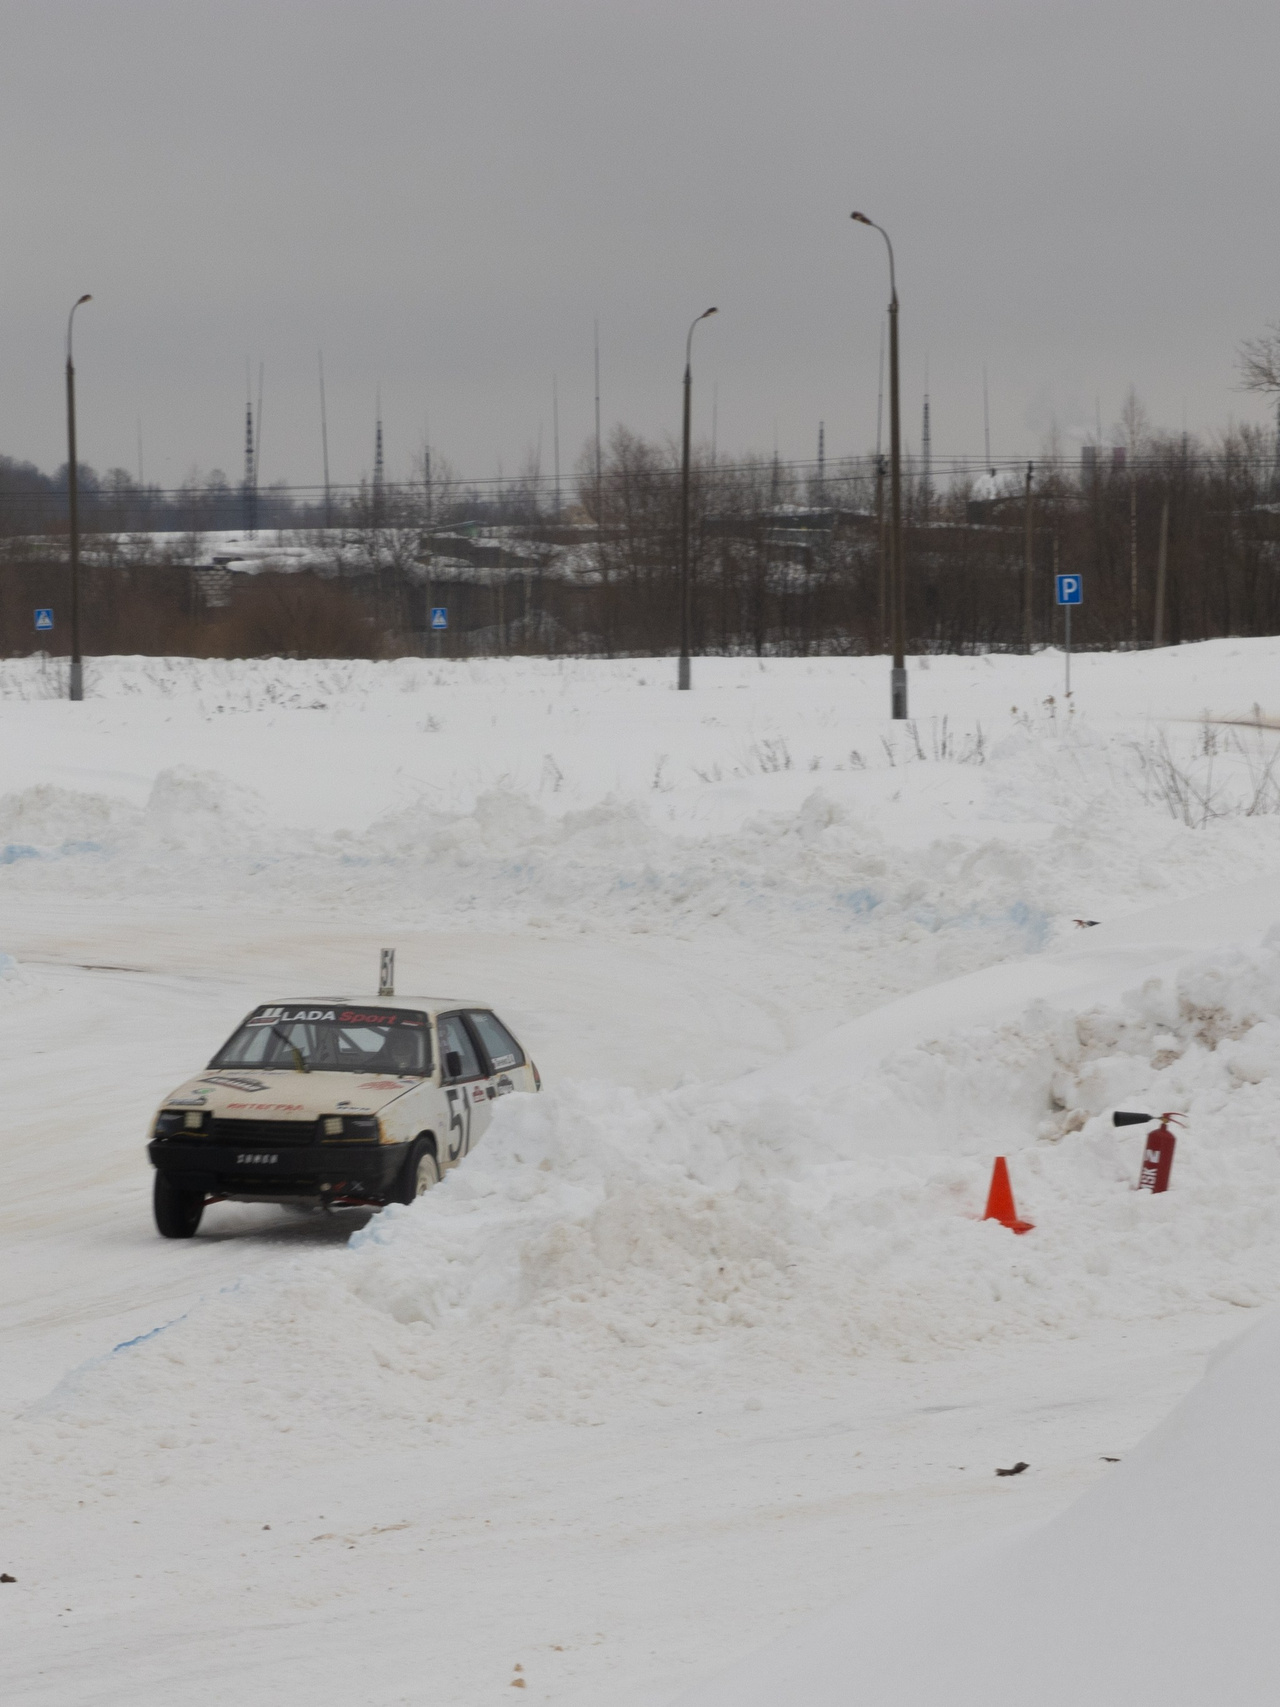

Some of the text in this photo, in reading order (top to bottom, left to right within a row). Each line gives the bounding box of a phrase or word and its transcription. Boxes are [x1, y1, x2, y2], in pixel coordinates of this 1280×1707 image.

[1062, 578, 1078, 601] P
[381, 950, 395, 987] 51
[280, 1010, 336, 1022] LADA
[338, 1011, 397, 1024] Sport
[446, 1086, 471, 1162] 51
